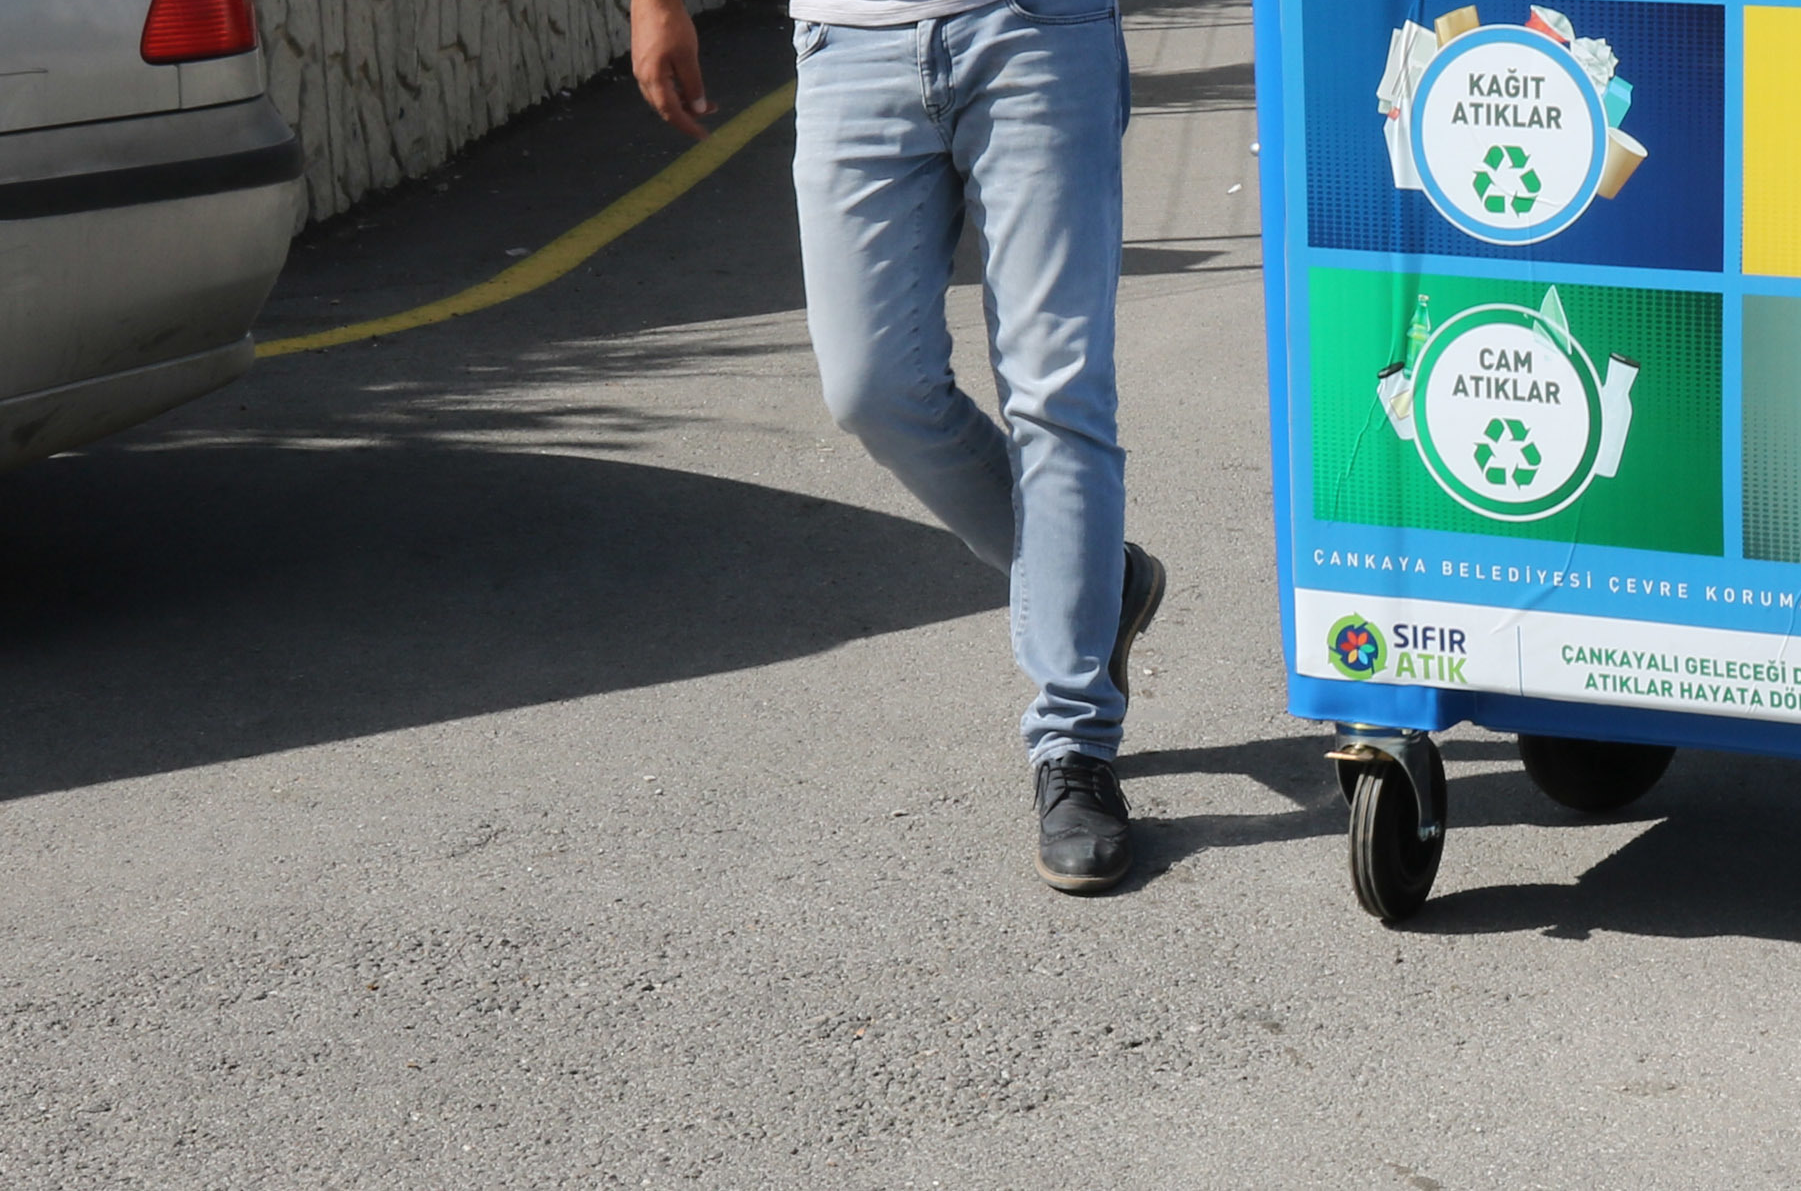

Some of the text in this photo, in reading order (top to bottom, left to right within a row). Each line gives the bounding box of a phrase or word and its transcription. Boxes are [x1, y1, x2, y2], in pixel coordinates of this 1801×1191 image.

[1468, 68, 1546, 100] KAĞIT
[1451, 101, 1563, 130] ATIKLAR
[1479, 347, 1533, 374] CAM
[1451, 374, 1561, 405] ATIKLAR
[1313, 548, 1427, 574] ÇANKAYA
[1442, 560, 1592, 589] BELEDİYESİ
[1608, 576, 1689, 599] ÇEVRE
[1393, 623, 1467, 654] SIFIR
[1394, 651, 1468, 684] ATIK
[1561, 643, 1680, 674] ÇANKAYALI
[1684, 656, 1787, 684] GELECEĞİ
[1584, 672, 1674, 698] ATIKLAR
[1679, 682, 1764, 710] HAYATA
